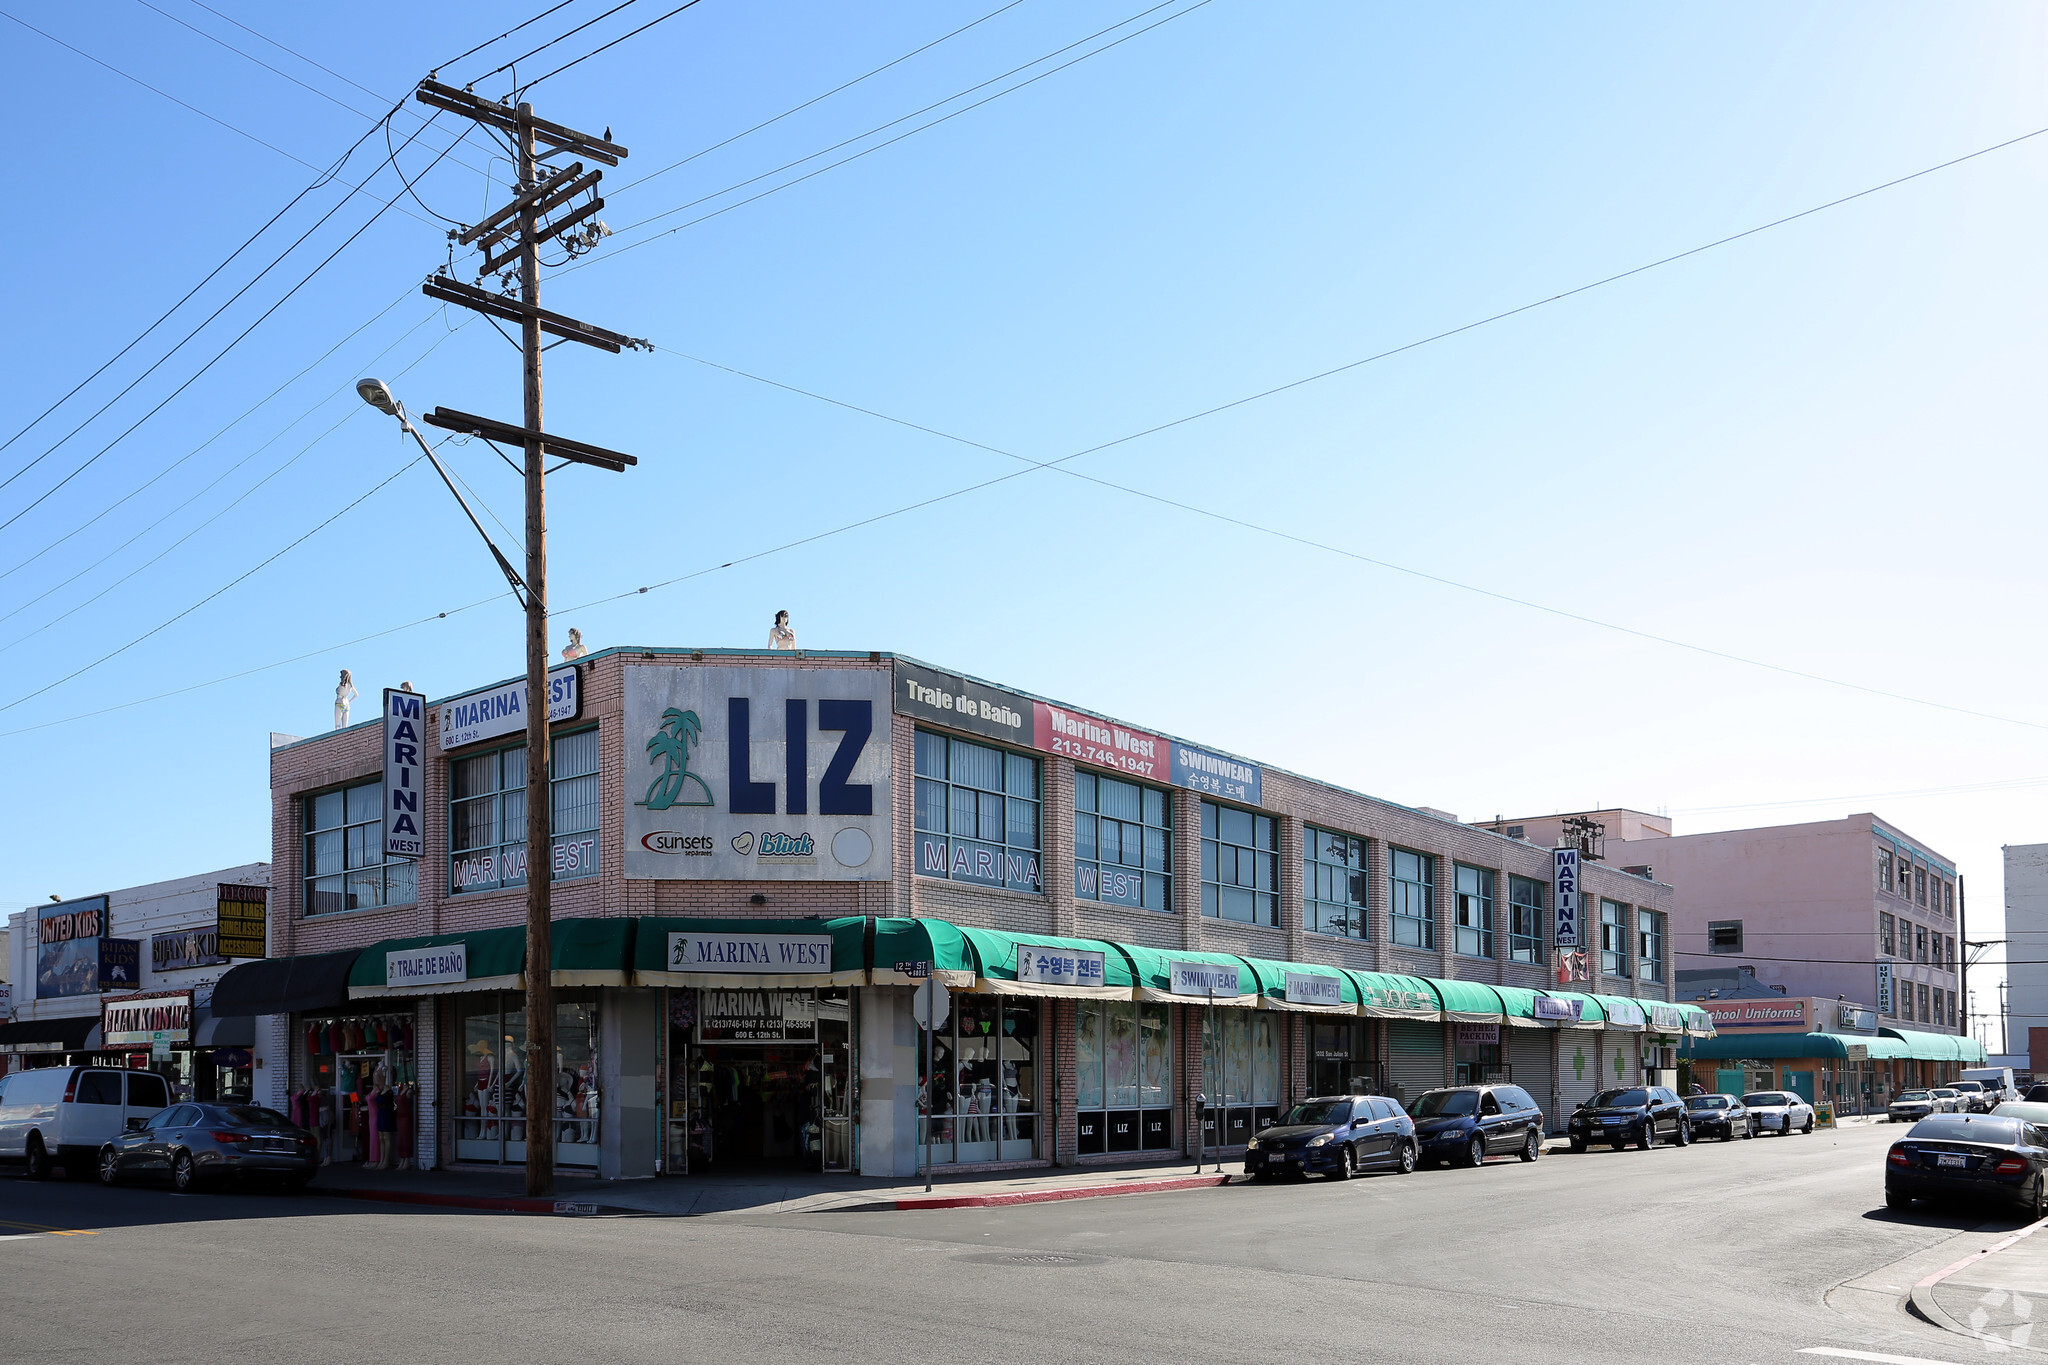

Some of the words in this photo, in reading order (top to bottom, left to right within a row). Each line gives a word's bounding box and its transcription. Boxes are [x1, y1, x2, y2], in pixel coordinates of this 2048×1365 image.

[455, 691, 520, 729] MARINA
[906, 679, 953, 710] Traje
[955, 695, 978, 716] de
[980, 700, 1022, 728] Baño
[461, 732, 472, 742] 12th
[548, 705, 571, 719] 46-1947
[1051, 710, 1111, 746] Marina
[1114, 729, 1155, 758] West
[392, 695, 420, 836] MARINA
[728, 697, 872, 815] LIZ
[1052, 737, 1154, 775] 213.746.1947
[1180, 748, 1253, 784] SWIMWEAR
[1188, 772, 1221, 793] 수영복
[1224, 783, 1245, 800] 도매
[389, 839, 421, 853] WEST
[656, 834, 713, 850] sunsets
[758, 832, 814, 855] blink
[453, 850, 527, 887] MARINA
[552, 839, 594, 873] EST
[924, 841, 1041, 886] MARINA
[1079, 867, 1142, 900] WEST
[218, 885, 267, 902] PRECIOUS
[1557, 852, 1575, 934] MARINA
[220, 901, 242, 916] HAND
[243, 903, 265, 918] BAGS
[40, 913, 73, 944] UNITED
[75, 909, 99, 939] KIDS
[219, 920, 265, 937] SUNGLASSES
[101, 942, 137, 953] BIJAN
[219, 939, 265, 955] ACCESSORIES
[1556, 936, 1576, 944] WEST
[104, 954, 135, 965] KIDS
[697, 941, 771, 964] MARINA
[778, 943, 829, 965] WEST
[398, 958, 423, 977] TRAJE
[426, 957, 437, 975] DE
[439, 950, 463, 974] BAÑO
[1037, 955, 1075, 976] 수영복
[1077, 958, 1102, 978] 전문
[1181, 971, 1238, 989] SWIMWEAR
[1293, 981, 1320, 998] MARINA
[1321, 984, 1340, 999] WEST
[1879, 966, 1889, 1012] UNIFORMS
[705, 992, 765, 1016] MARINA
[768, 993, 811, 1016] WEST
[1745, 1007, 1801, 1019] Uniforms
[104, 1009, 137, 1033] BIJAN
[138, 1006, 170, 1031] KIDS
[712, 1020, 756, 1028] (213)746-1947
[1460, 1032, 1496, 1040] PACKING
[1081, 1125, 1093, 1135] LIZ
[1117, 1123, 1128, 1133] LIZ
[1151, 1122, 1161, 1132] LIZ
[1204, 1120, 1214, 1129] LIZ
[1234, 1119, 1243, 1128] LIZ
[1262, 1118, 1271, 1126] LIZ
